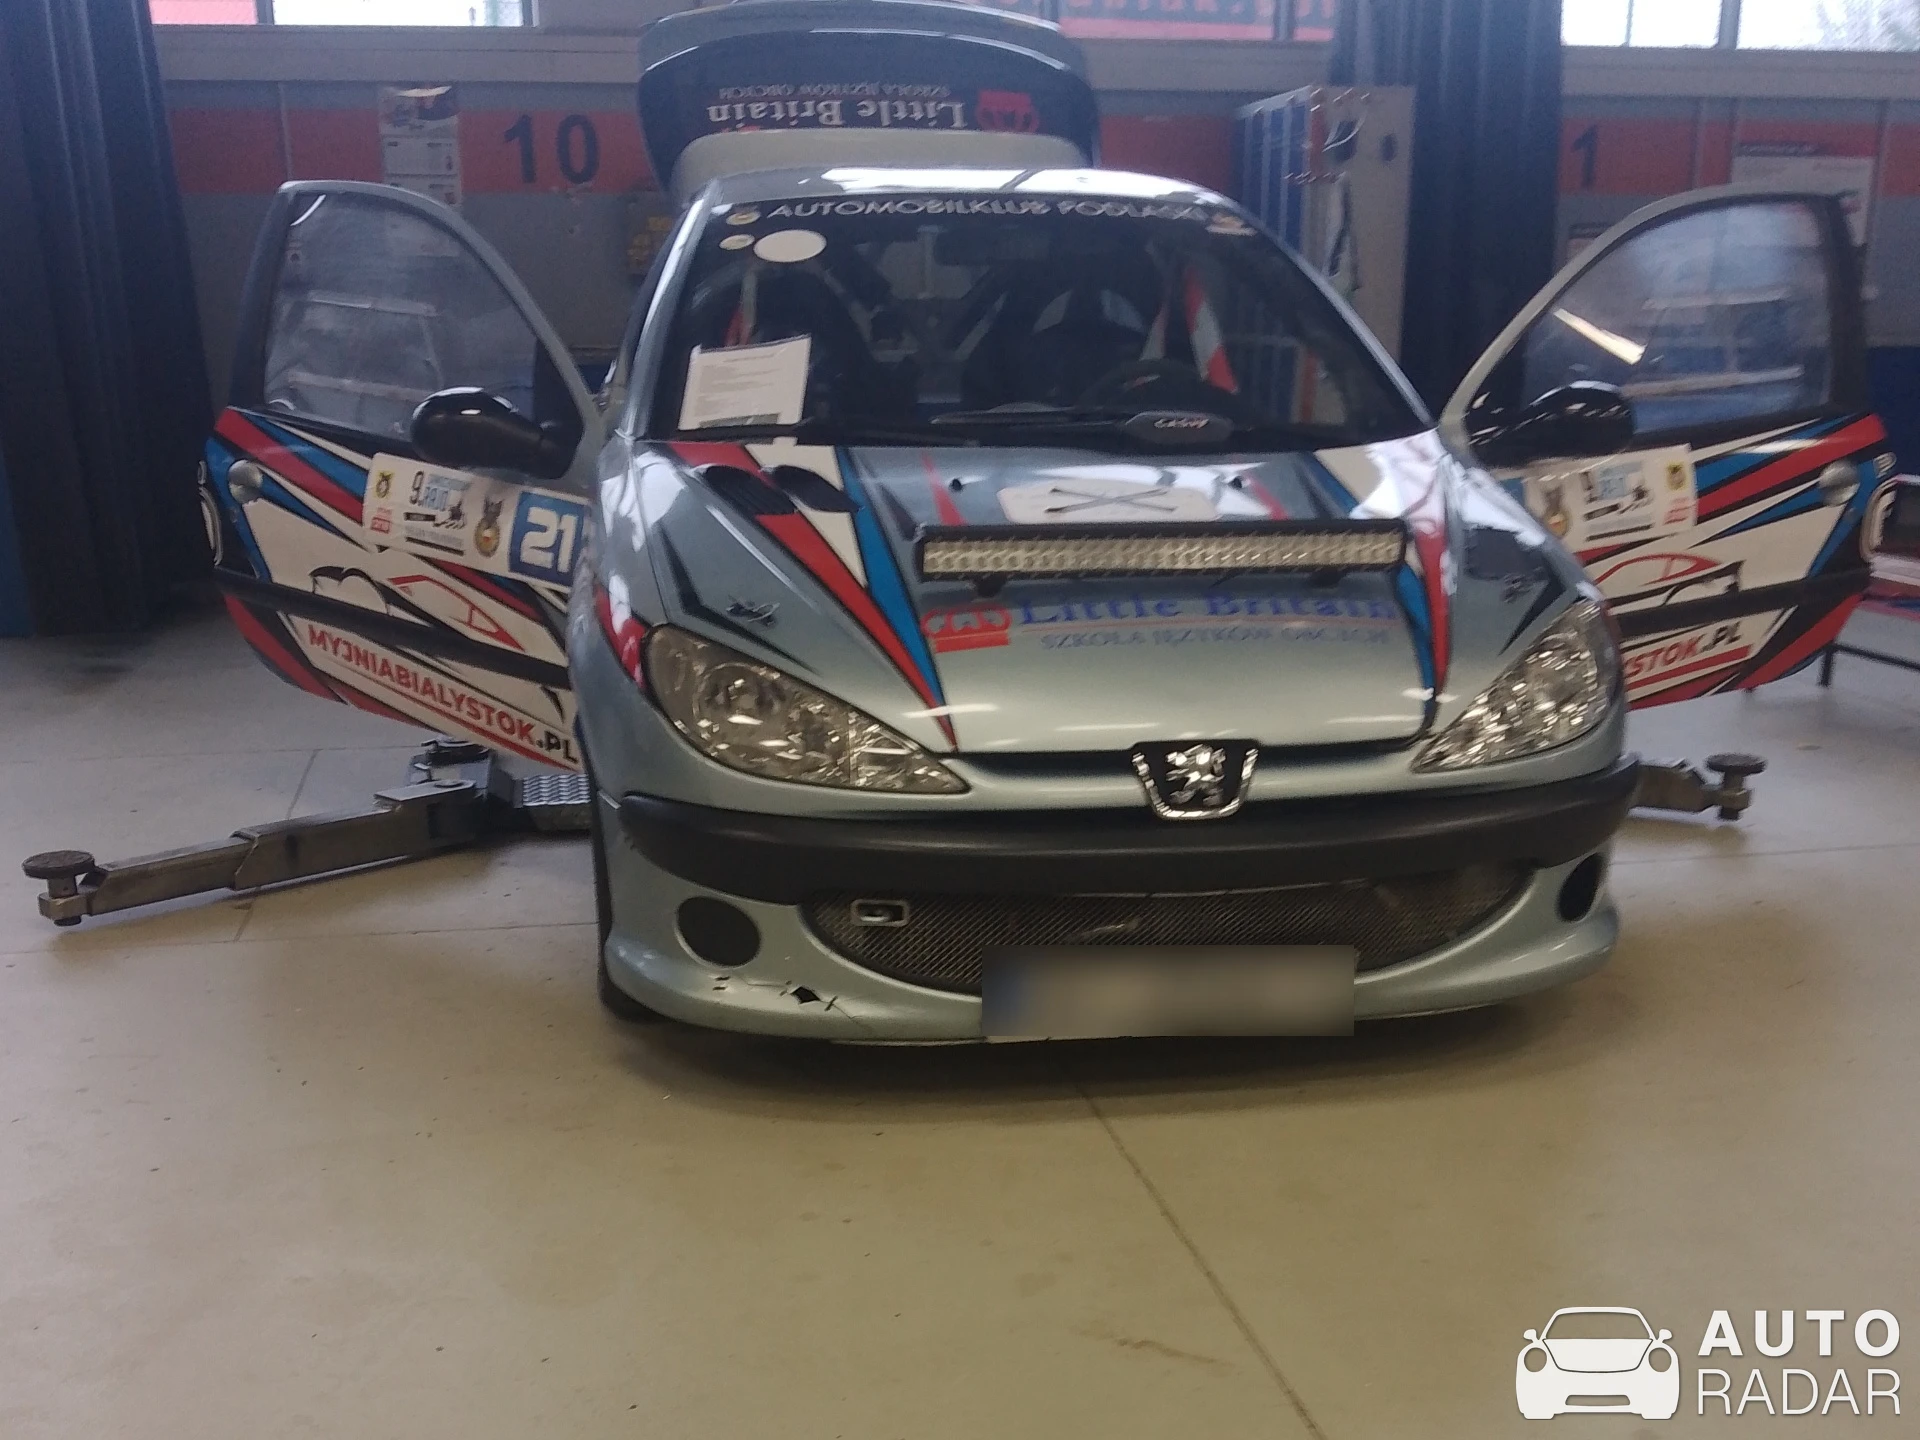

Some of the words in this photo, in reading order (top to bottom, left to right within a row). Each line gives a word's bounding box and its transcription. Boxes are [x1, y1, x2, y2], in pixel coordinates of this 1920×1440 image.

[706, 99, 844, 127] Britain
[857, 98, 969, 128] Little
[503, 114, 599, 185] 10
[766, 199, 1051, 219] AUTOMOBILKLUB
[519, 506, 580, 574] 21
[1020, 597, 1184, 625] Little
[1205, 595, 1398, 620] Britain
